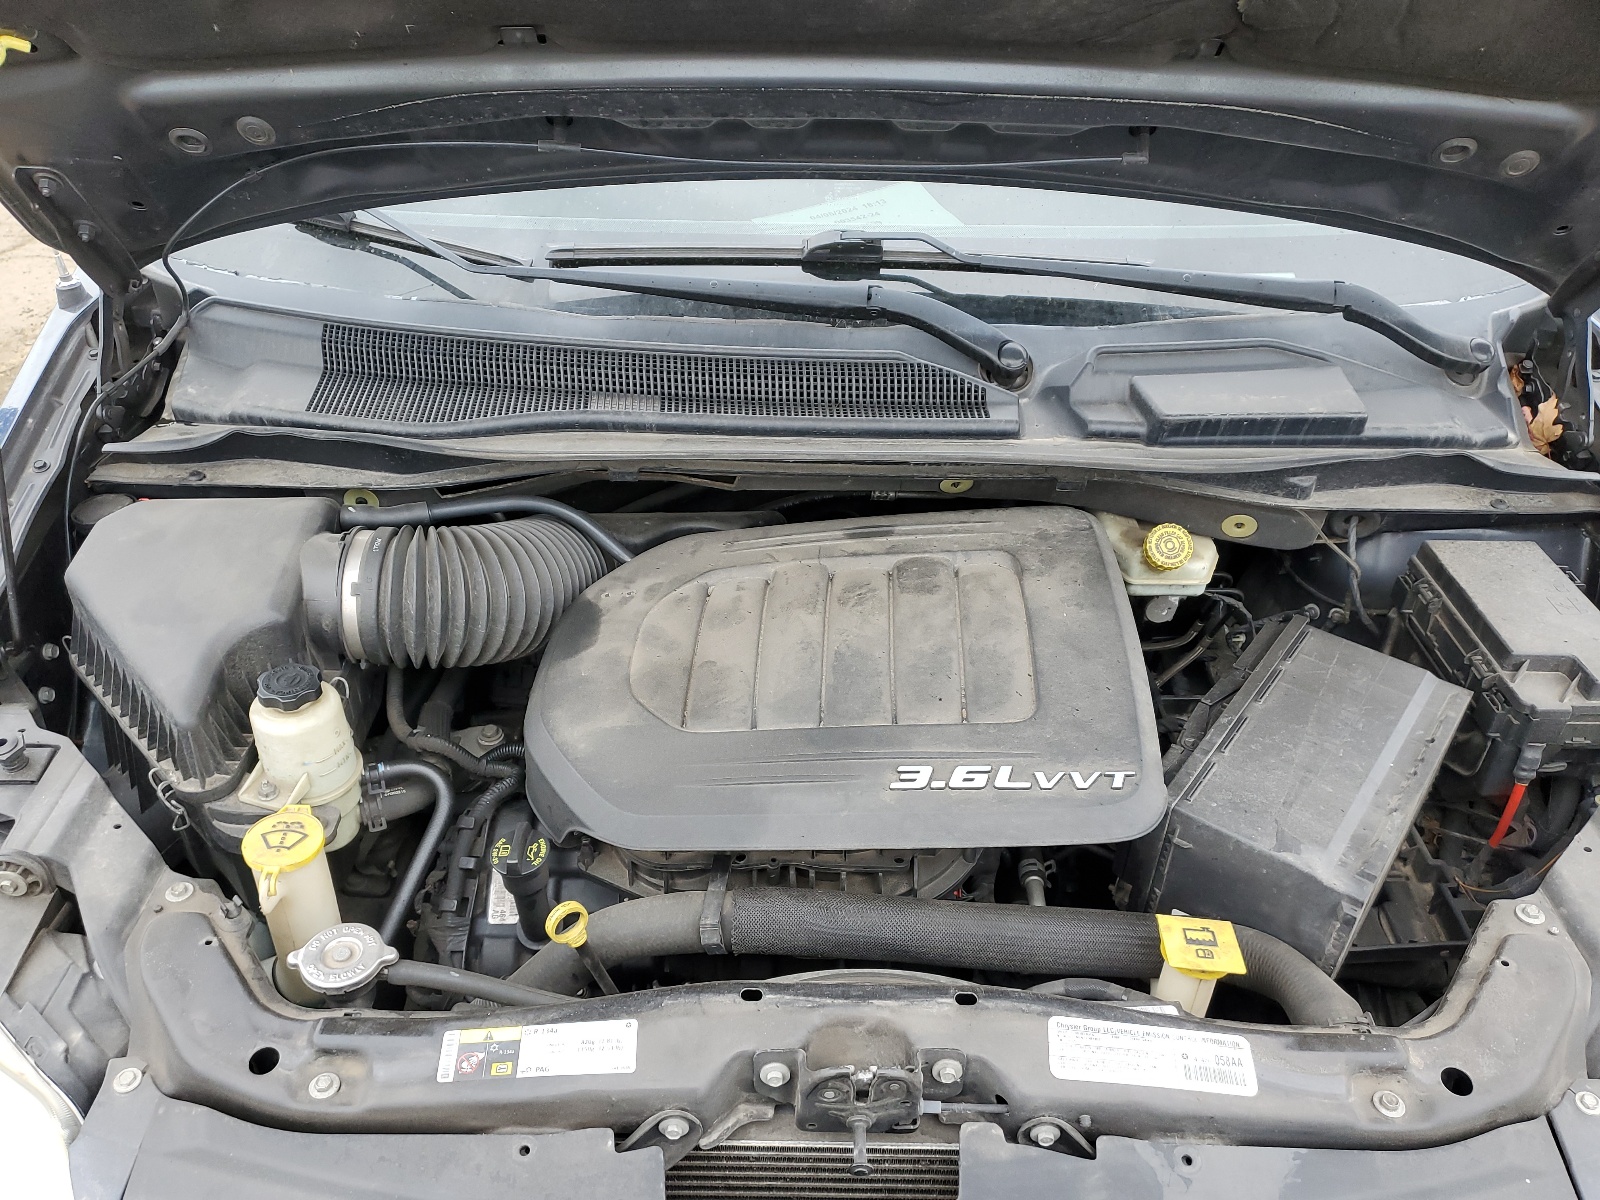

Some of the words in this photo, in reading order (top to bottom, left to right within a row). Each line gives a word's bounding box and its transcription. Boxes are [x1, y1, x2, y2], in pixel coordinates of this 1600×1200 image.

[889, 765, 1032, 790] 3.6L
[1032, 771, 1137, 790] VVT
[319, 928, 339, 941] NOT
[1056, 1022, 1082, 1031] Chrysler
[1082, 1025, 1101, 1033] Group
